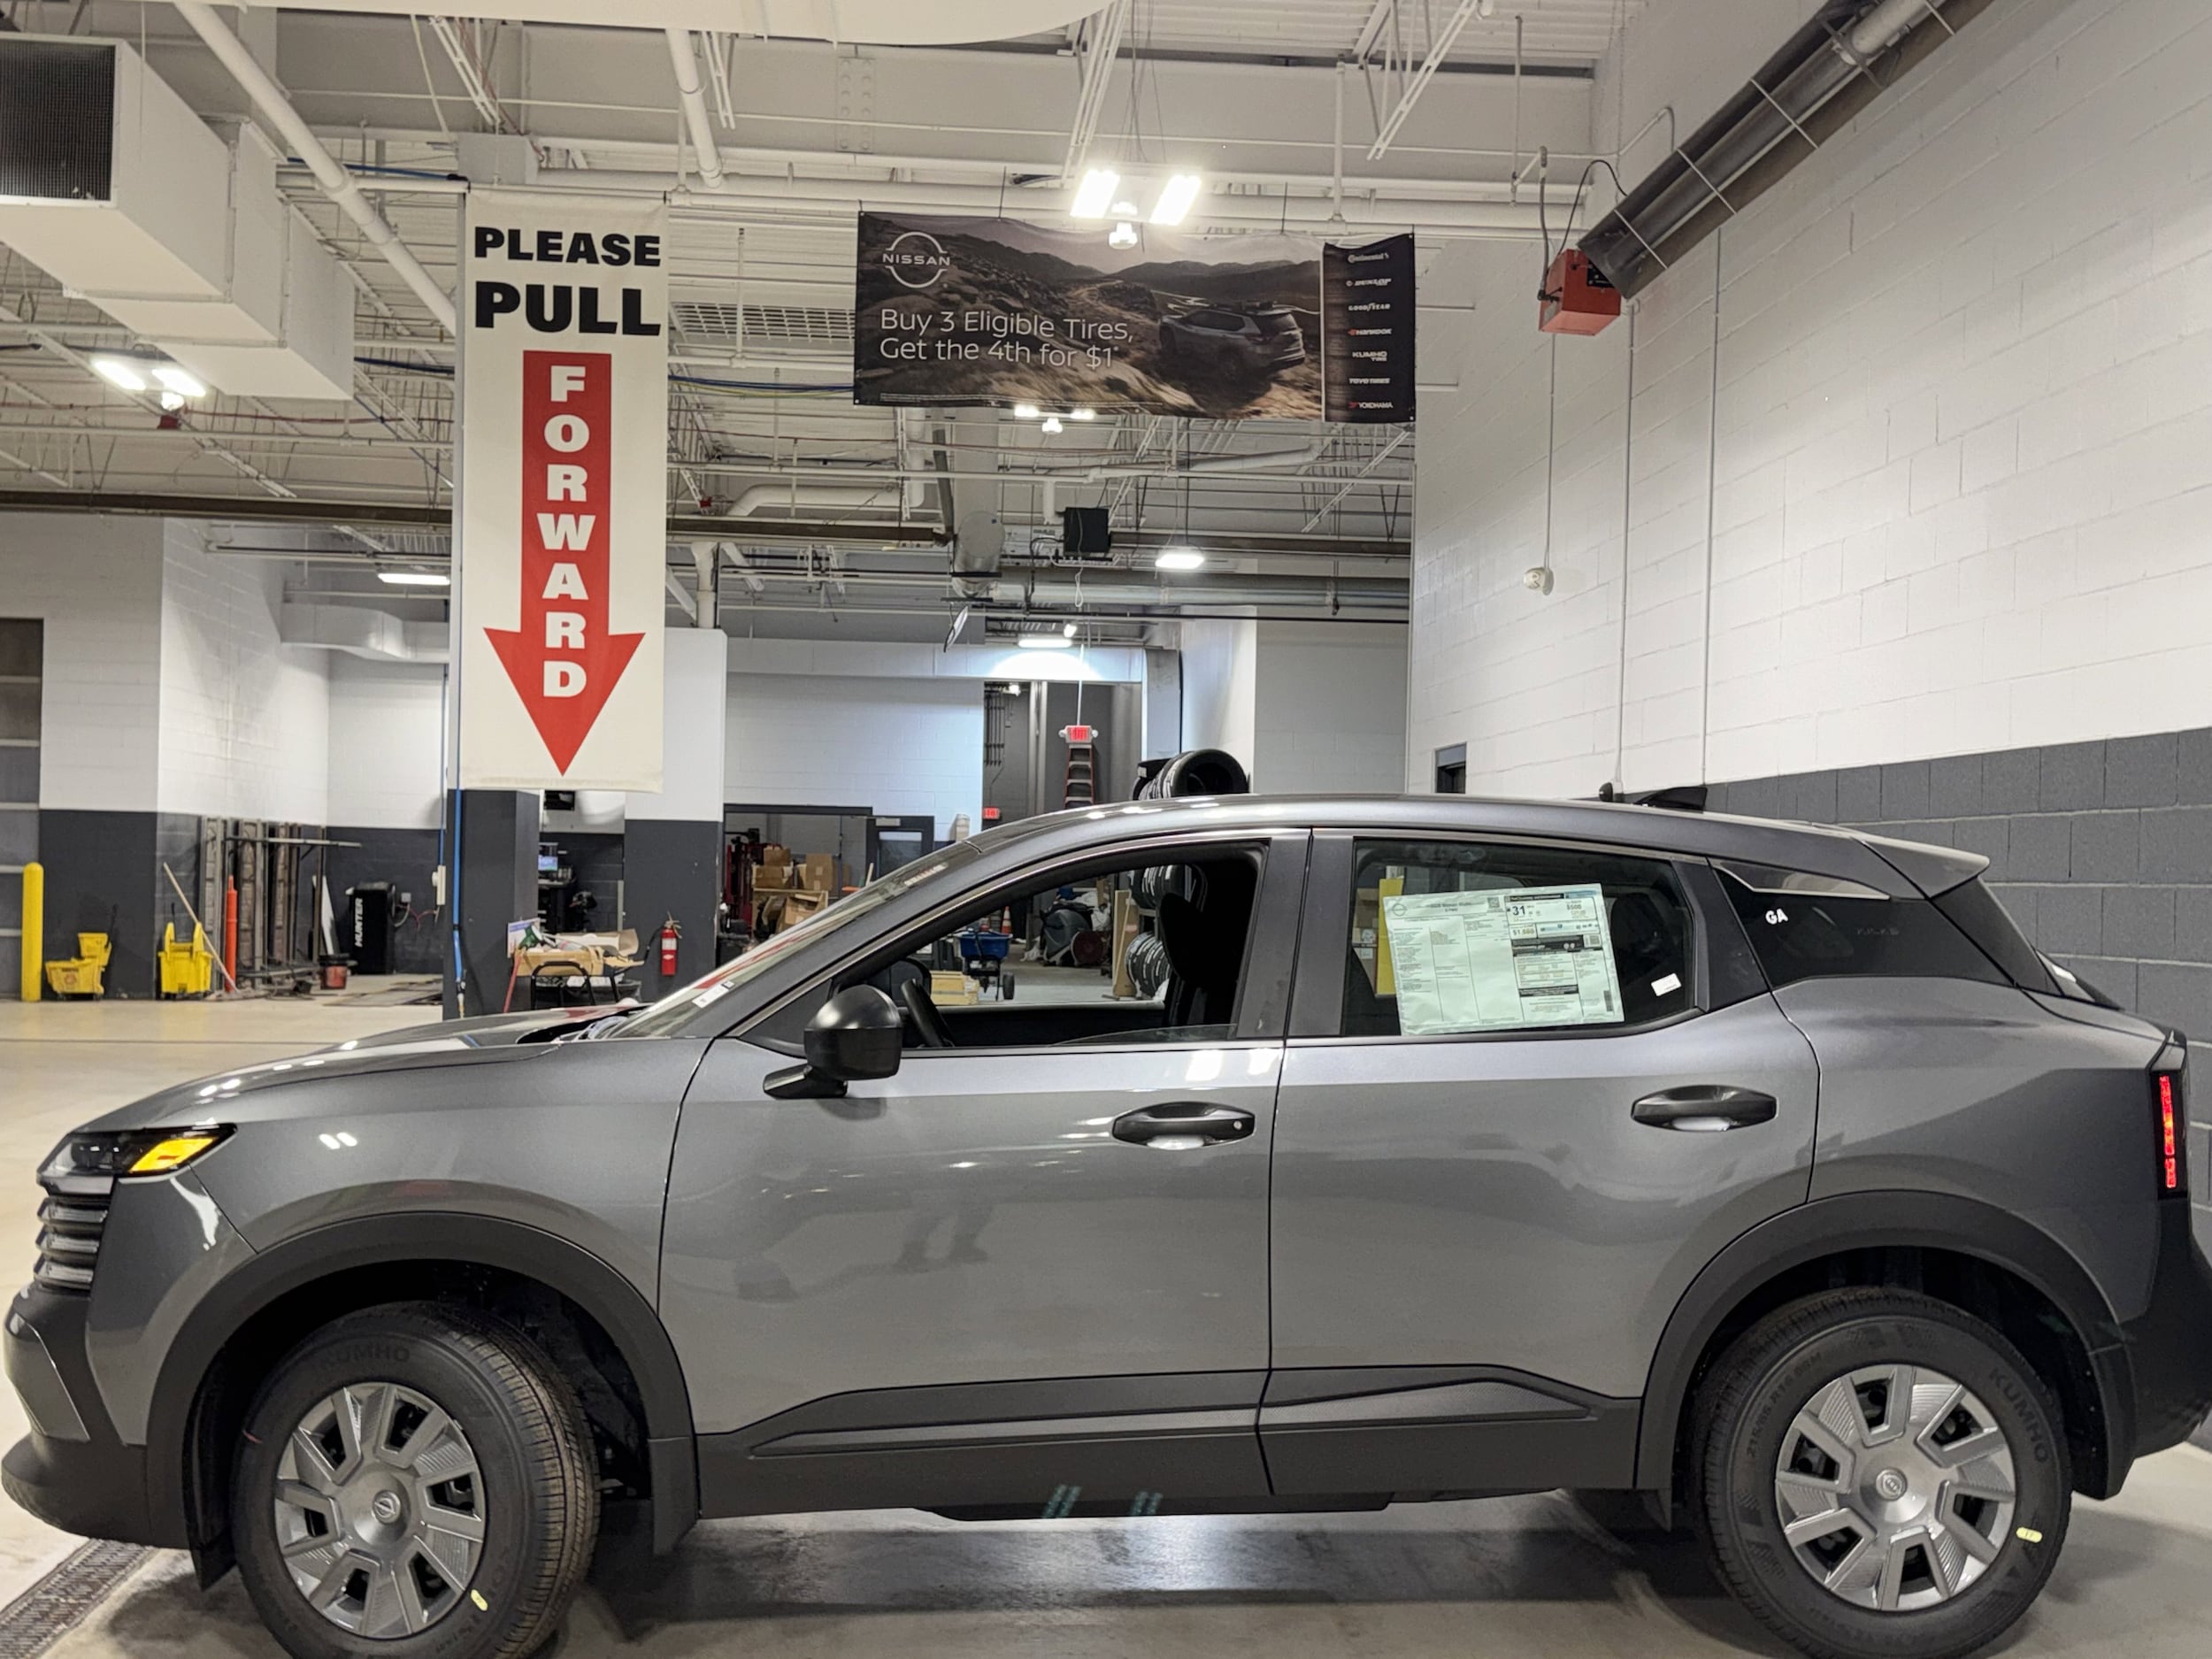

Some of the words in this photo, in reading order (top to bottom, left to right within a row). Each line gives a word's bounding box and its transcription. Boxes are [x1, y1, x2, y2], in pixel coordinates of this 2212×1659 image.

[475, 227, 661, 267] PLEASE
[882, 253, 950, 266] NISSAN
[475, 280, 661, 336] PULL
[881, 309, 933, 336] Buy
[940, 311, 955, 332] 3
[964, 310, 1056, 338] Eligible
[1063, 319, 1133, 343] Tires,
[880, 337, 927, 360] Get
[935, 339, 979, 360] the
[987, 341, 1031, 364] 4th
[1039, 343, 1079, 367] for
[536, 365, 596, 697] FORWARD
[355, 897, 364, 948] HUNTER
[1511, 905, 1526, 916] 31
[1765, 908, 1789, 926] GA
